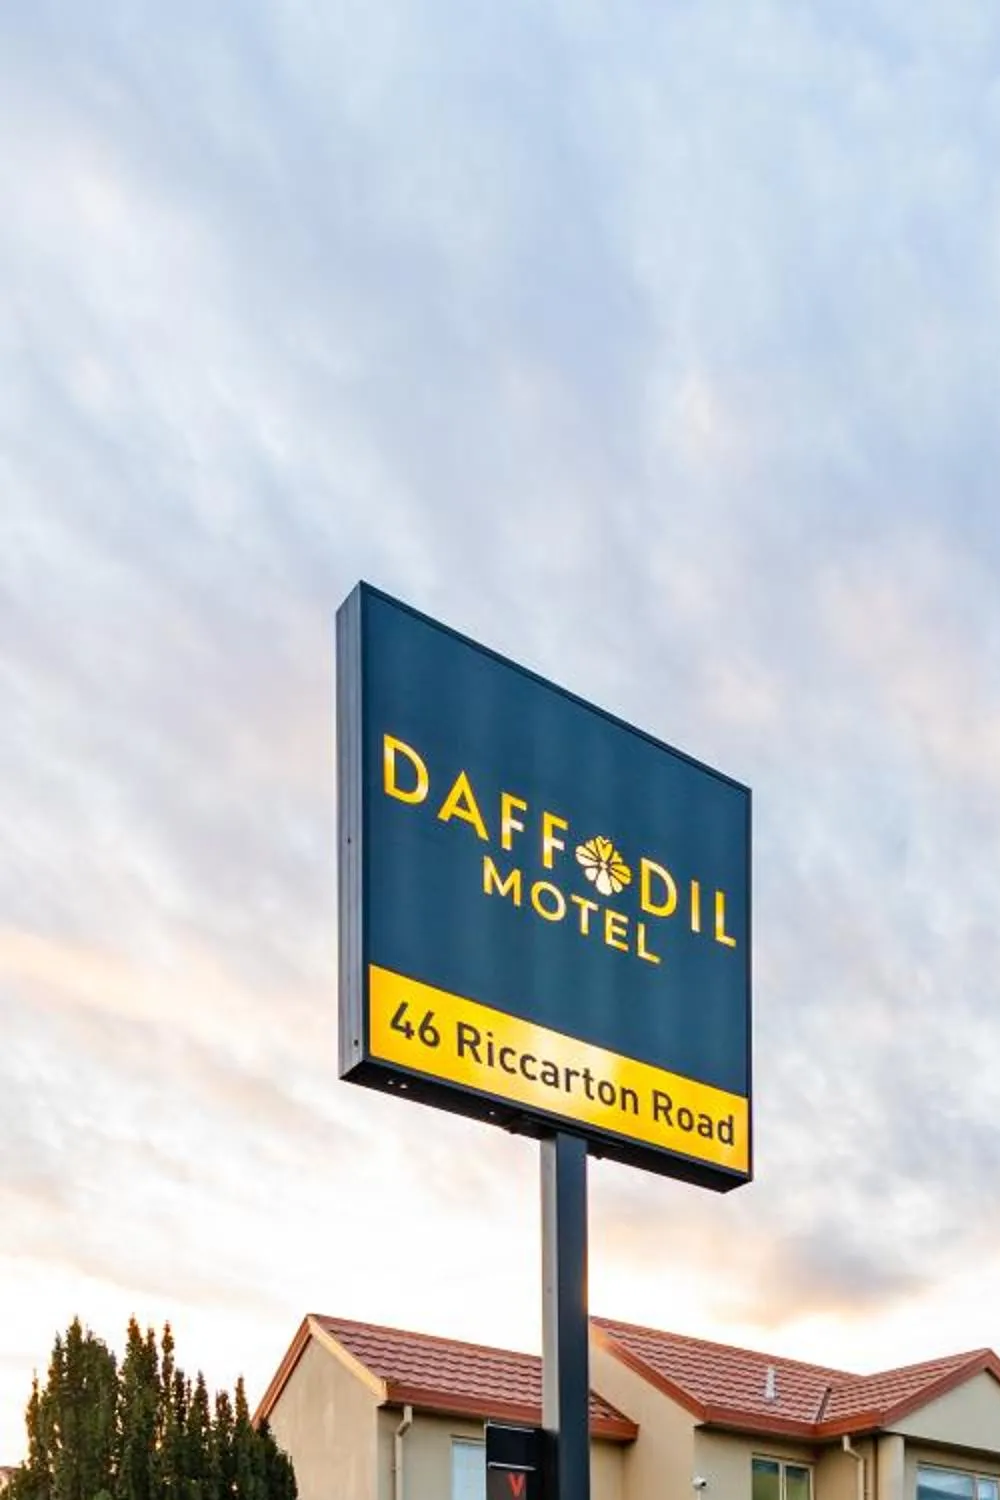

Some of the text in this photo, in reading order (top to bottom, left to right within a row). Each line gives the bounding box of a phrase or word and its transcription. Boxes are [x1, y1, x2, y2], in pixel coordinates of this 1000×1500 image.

[483, 856, 660, 964] MOTEL
[389, 1001, 735, 1147] 46 Riccarton Road
